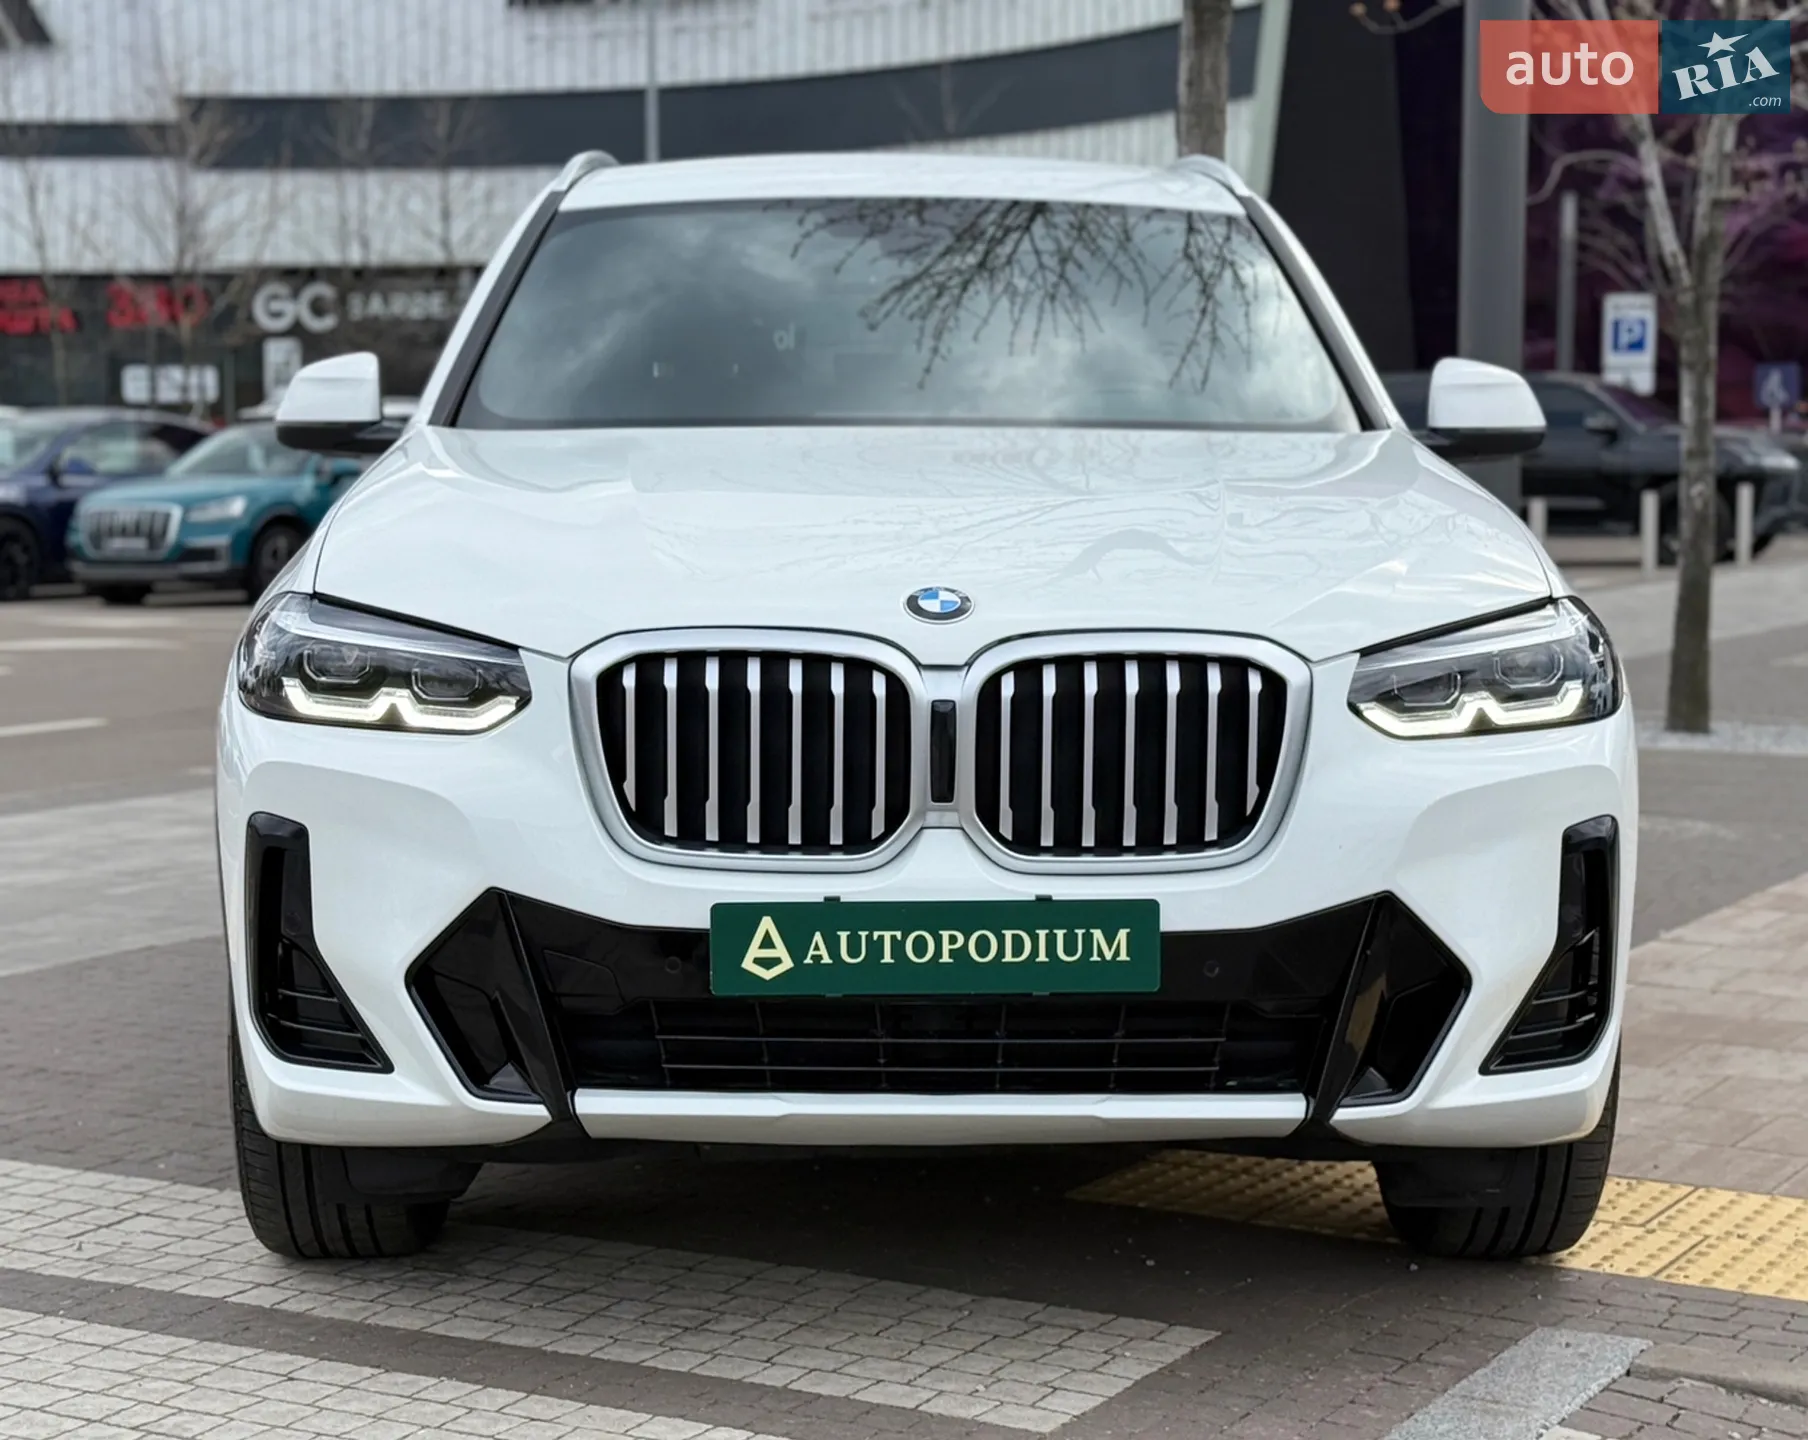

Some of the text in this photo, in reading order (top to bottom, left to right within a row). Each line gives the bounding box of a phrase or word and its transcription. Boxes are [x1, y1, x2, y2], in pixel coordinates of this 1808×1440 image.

[252, 280, 340, 334] GC
[1619, 318, 1644, 350] P
[803, 927, 1131, 965] AUTOPODIUM
